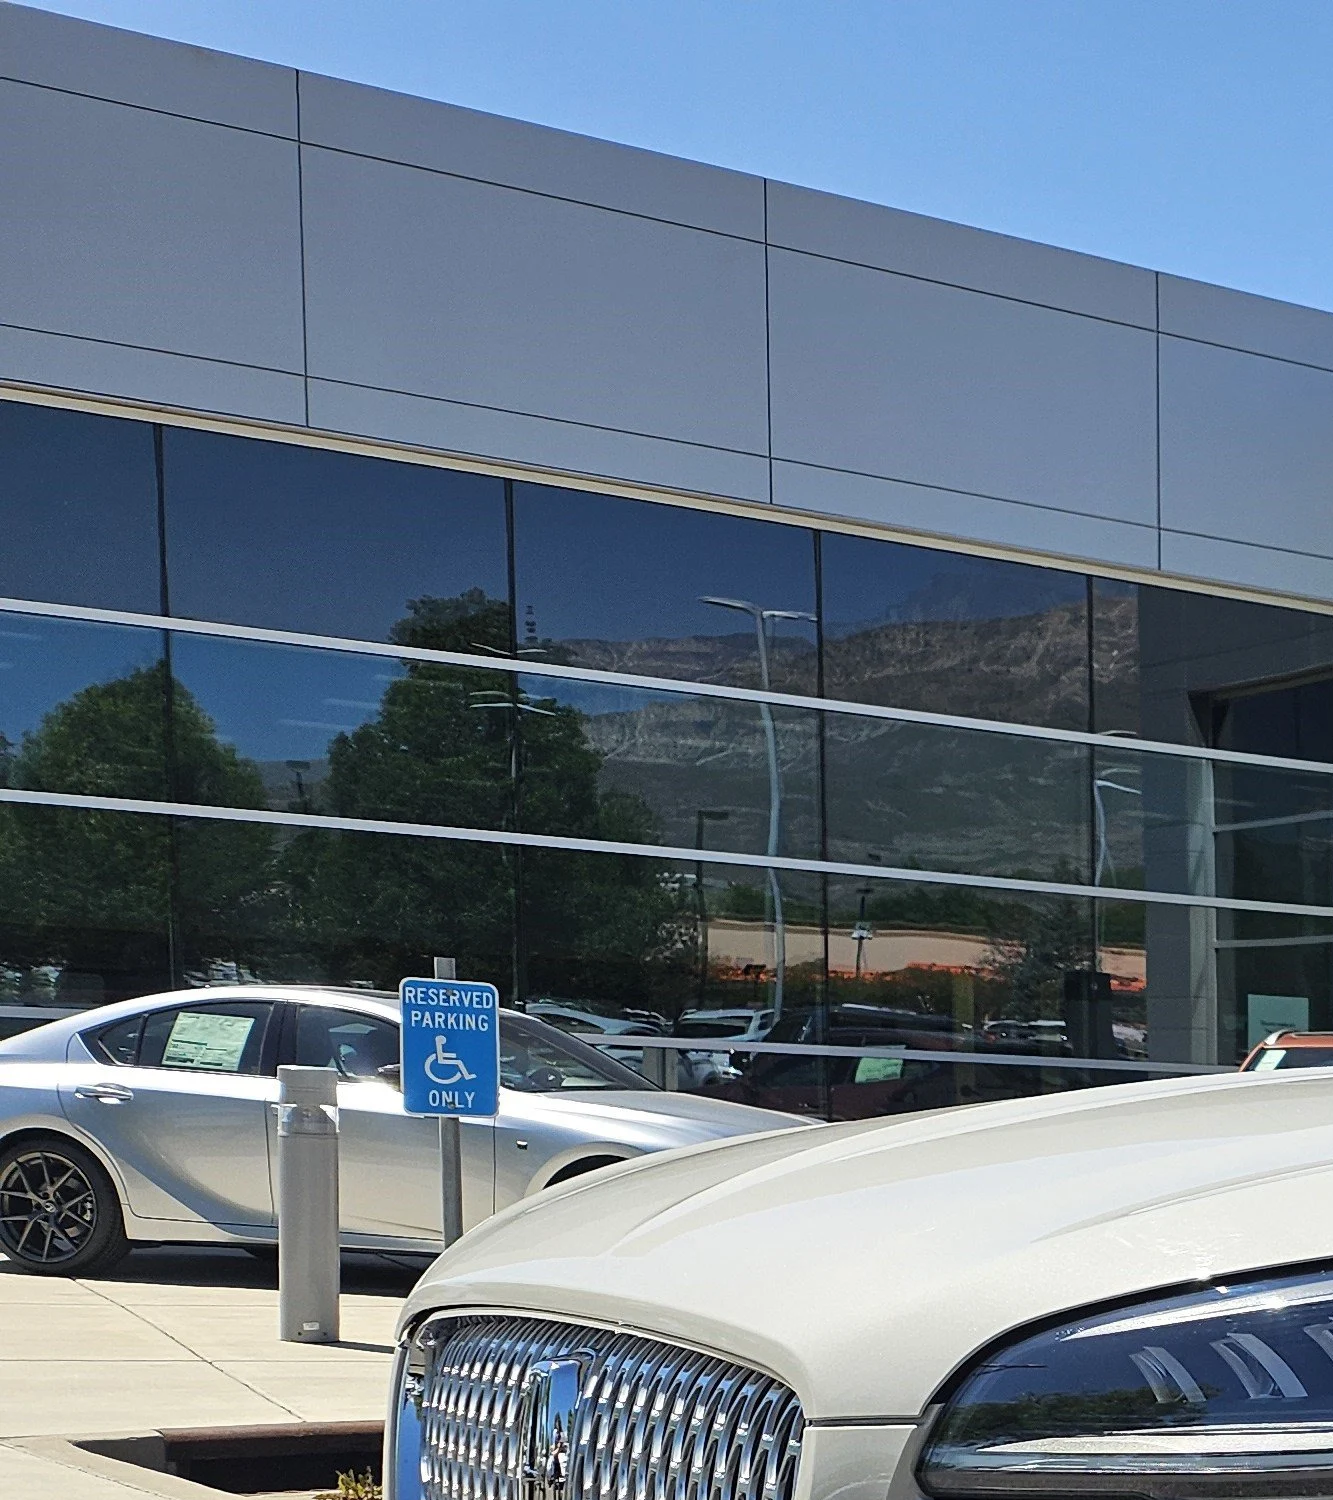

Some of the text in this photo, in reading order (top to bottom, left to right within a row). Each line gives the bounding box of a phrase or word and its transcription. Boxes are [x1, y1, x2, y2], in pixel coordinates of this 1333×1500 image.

[405, 987, 493, 1009] RESERVED
[411, 1011, 489, 1031] PARKING
[429, 1090, 475, 1109] ONLY
